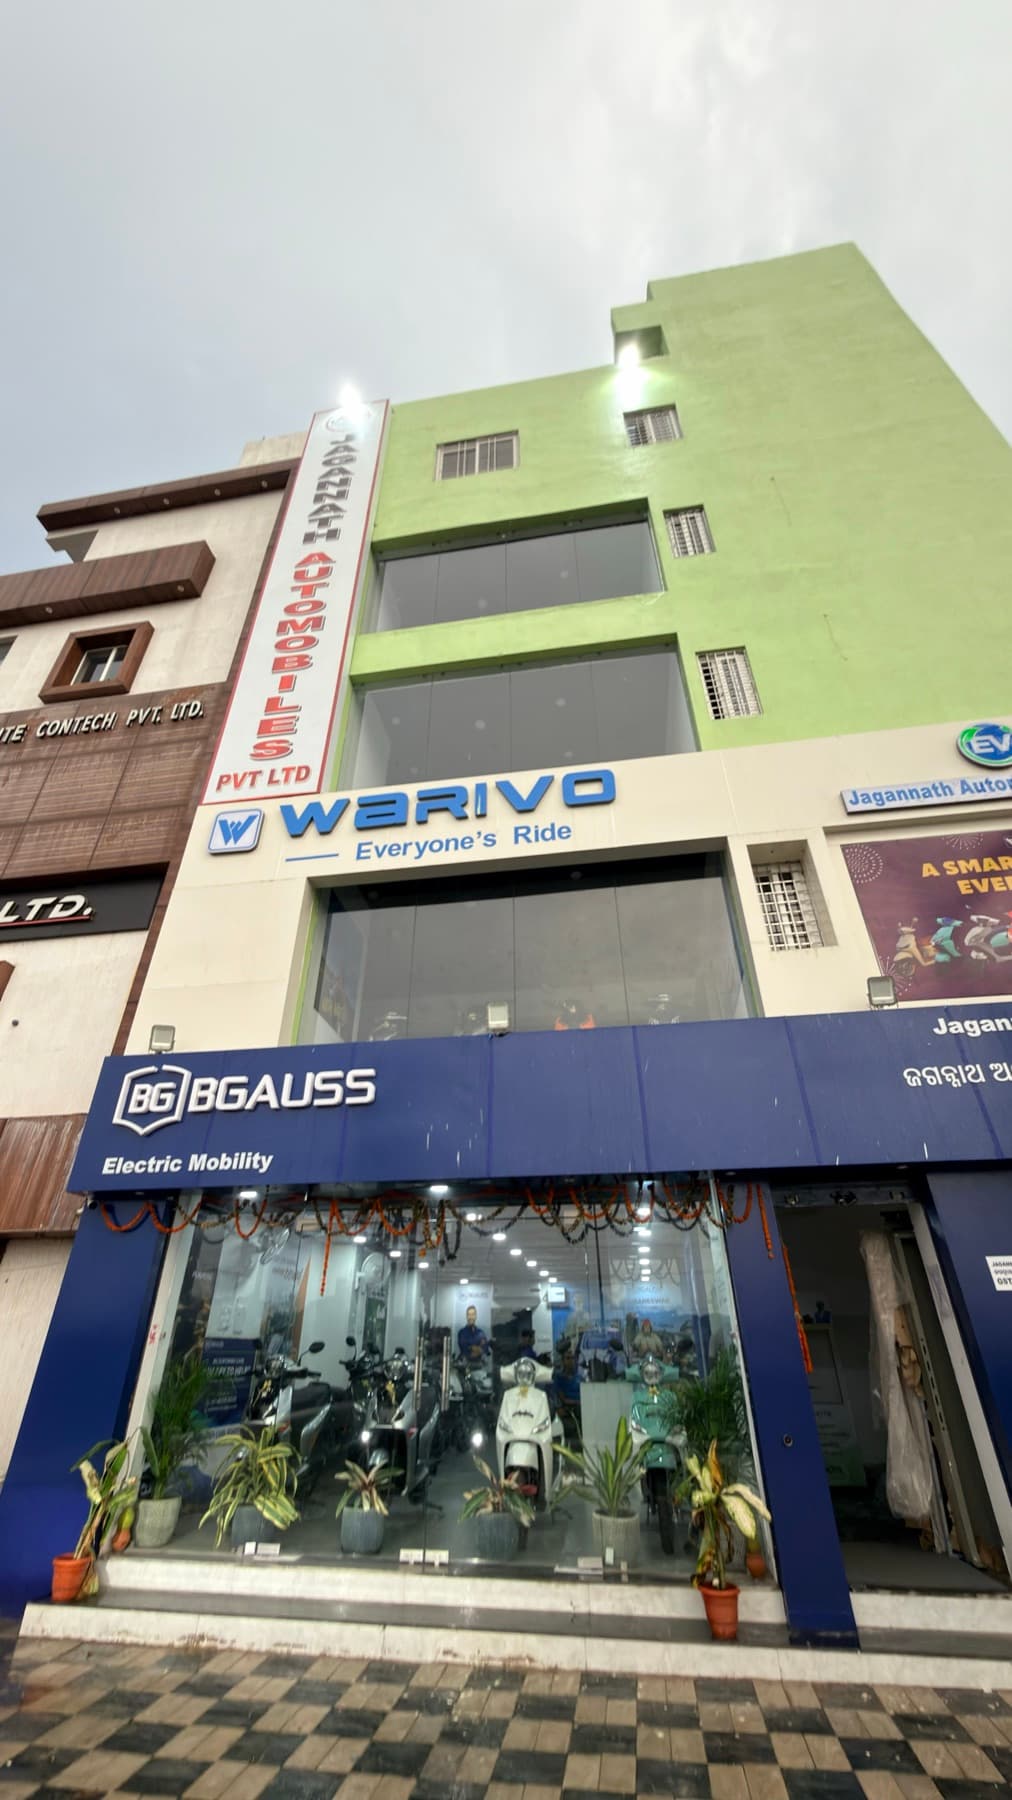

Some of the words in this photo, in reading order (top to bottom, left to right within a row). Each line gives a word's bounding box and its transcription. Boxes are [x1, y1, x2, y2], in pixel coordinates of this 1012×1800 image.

[303, 434, 359, 545] JAGANNATH
[250, 551, 336, 761] AUTOMOBILES
[36, 712, 116, 737] CONTECH
[126, 706, 161, 726] PVT.
[170, 700, 204, 720] LTD.
[971, 733, 1011, 754] EV
[216, 769, 261, 792] PVT
[267, 764, 312, 786] LTD
[849, 781, 954, 807] Jagannath
[960, 777, 1012, 795] Auto
[355, 830, 497, 861] Everyone's
[513, 822, 572, 846] Ride
[922, 862, 941, 878] A
[0, 894, 93, 923] LTD.
[933, 1017, 1012, 1037] Jagan
[127, 1081, 177, 1114] BG
[187, 1068, 377, 1114] BGAUSS
[102, 1156, 183, 1176] Electric
[188, 1151, 274, 1176] Mobility
